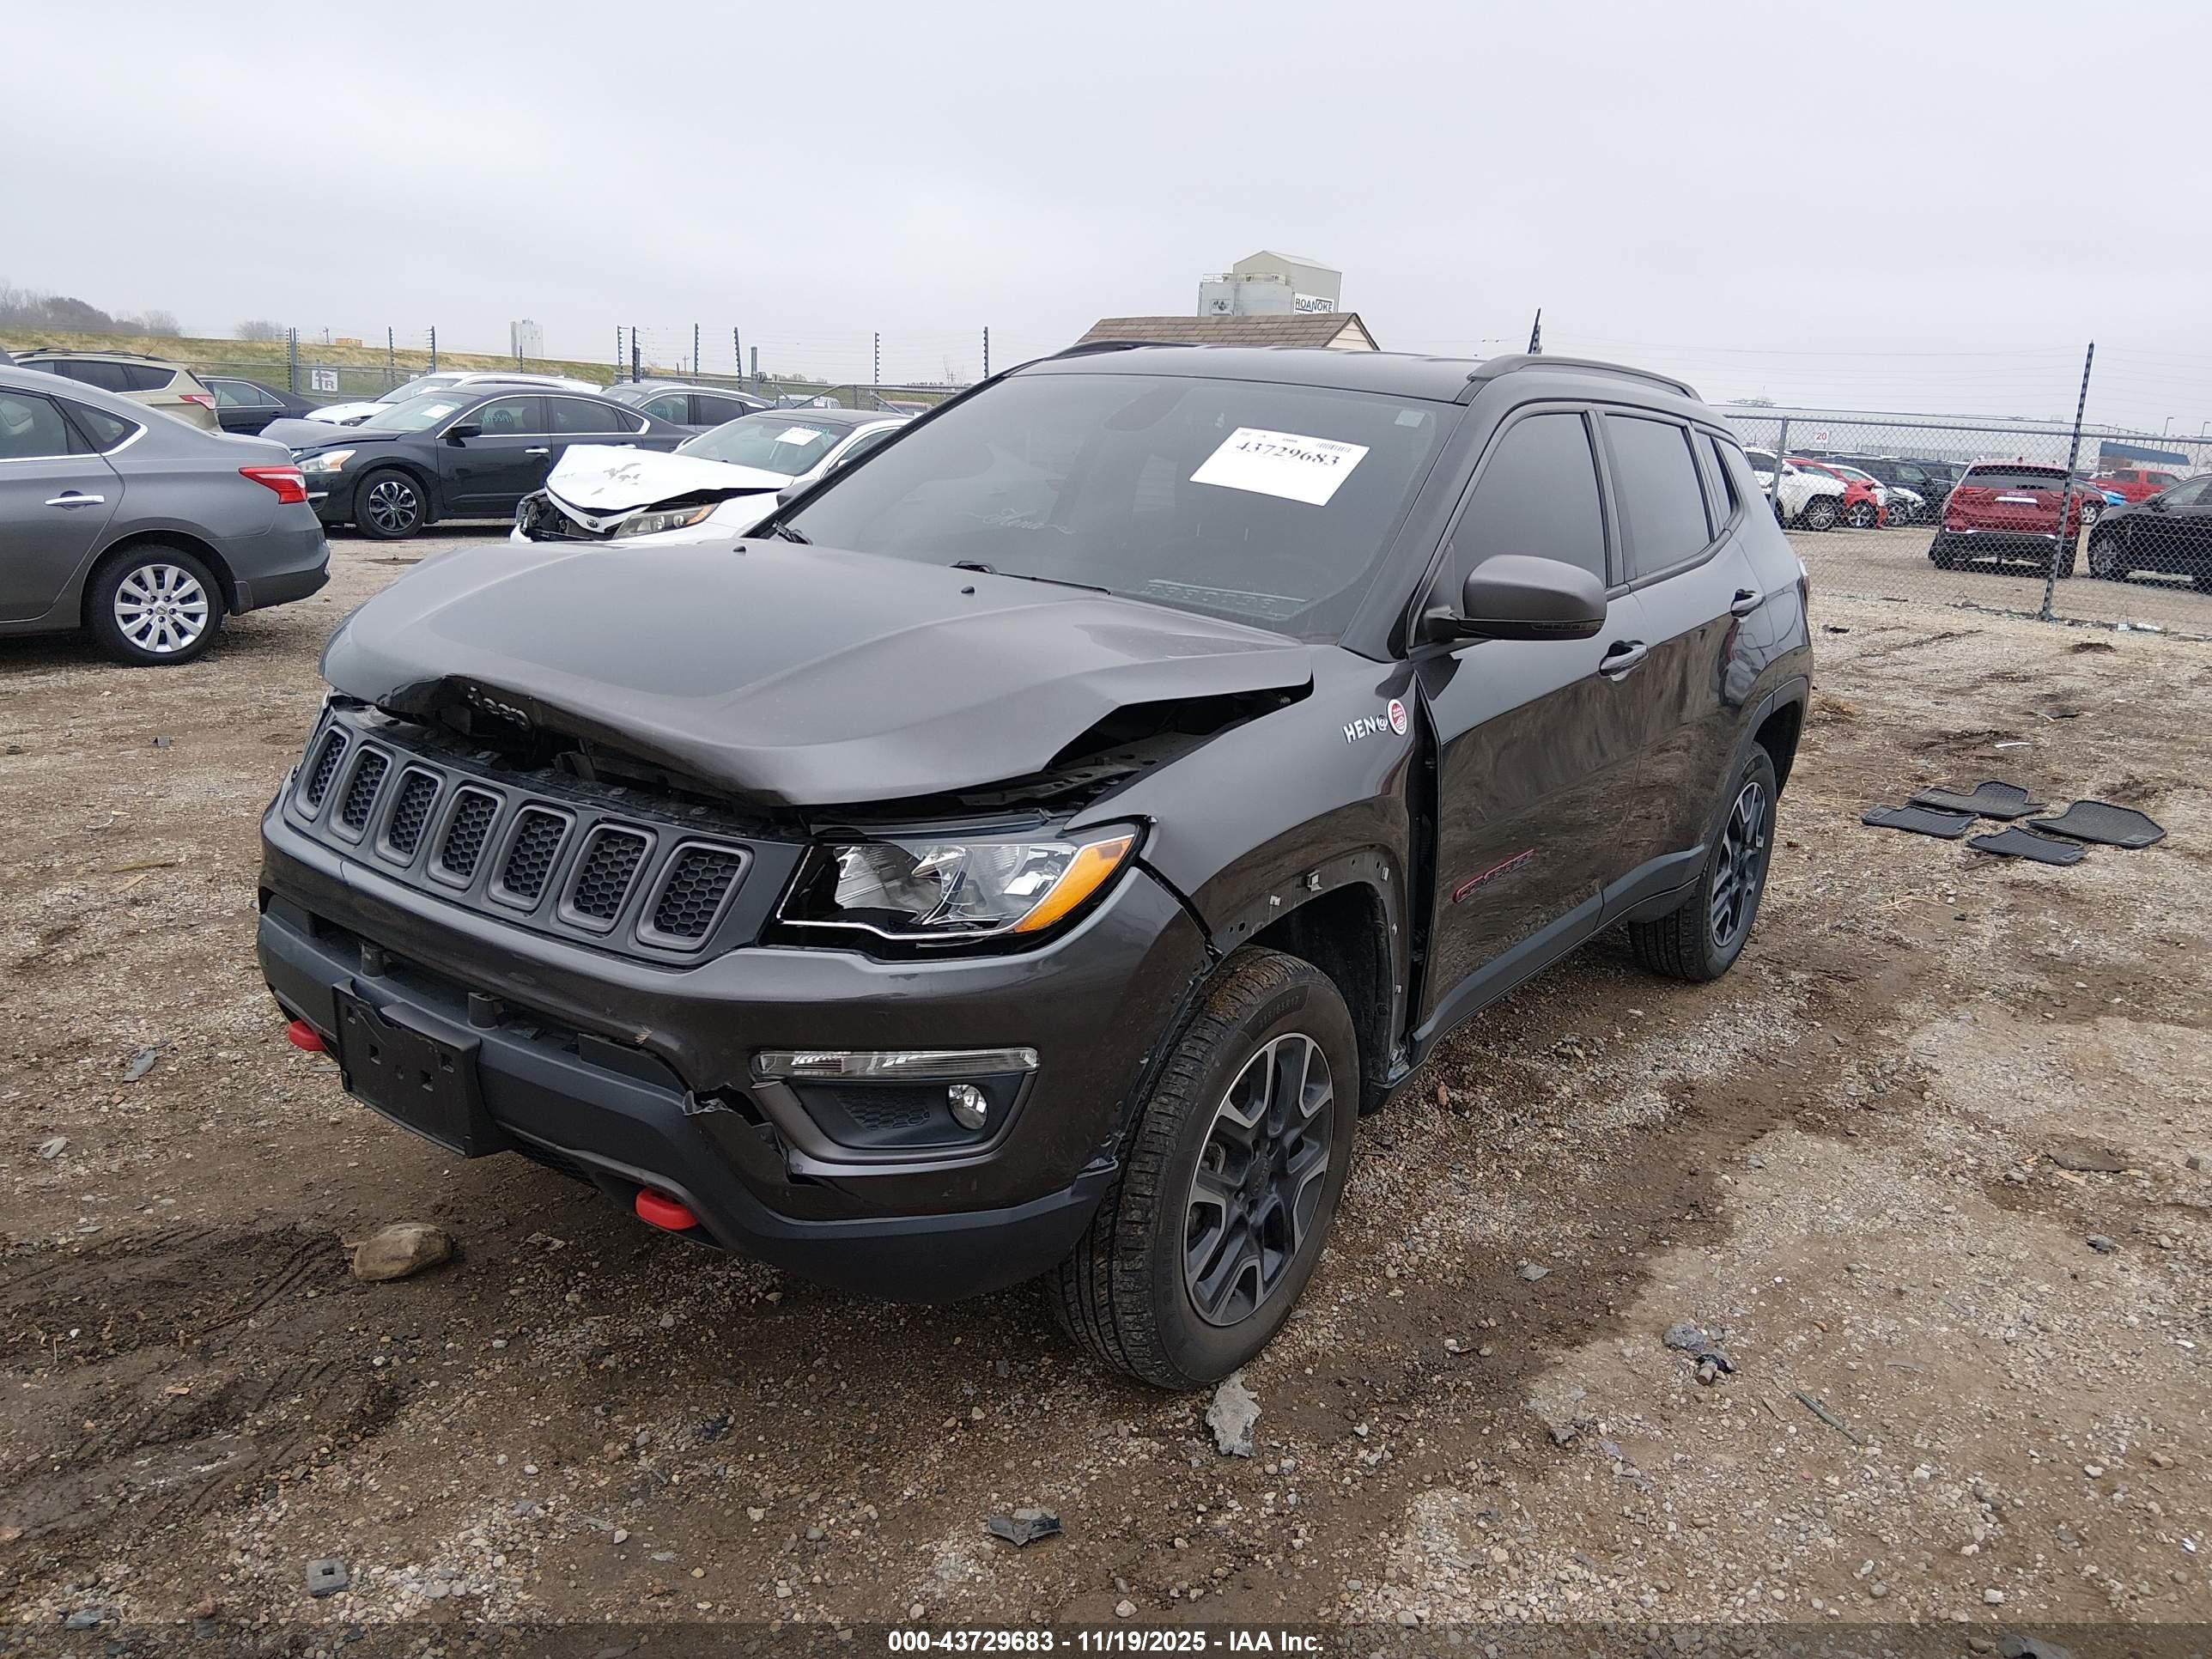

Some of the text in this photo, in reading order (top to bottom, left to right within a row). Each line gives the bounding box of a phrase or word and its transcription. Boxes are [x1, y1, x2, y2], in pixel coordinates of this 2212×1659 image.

[1295, 298, 1333, 313] ROANOKE
[1816, 432, 1827, 441] 20
[1237, 441, 1340, 466] 43729683
